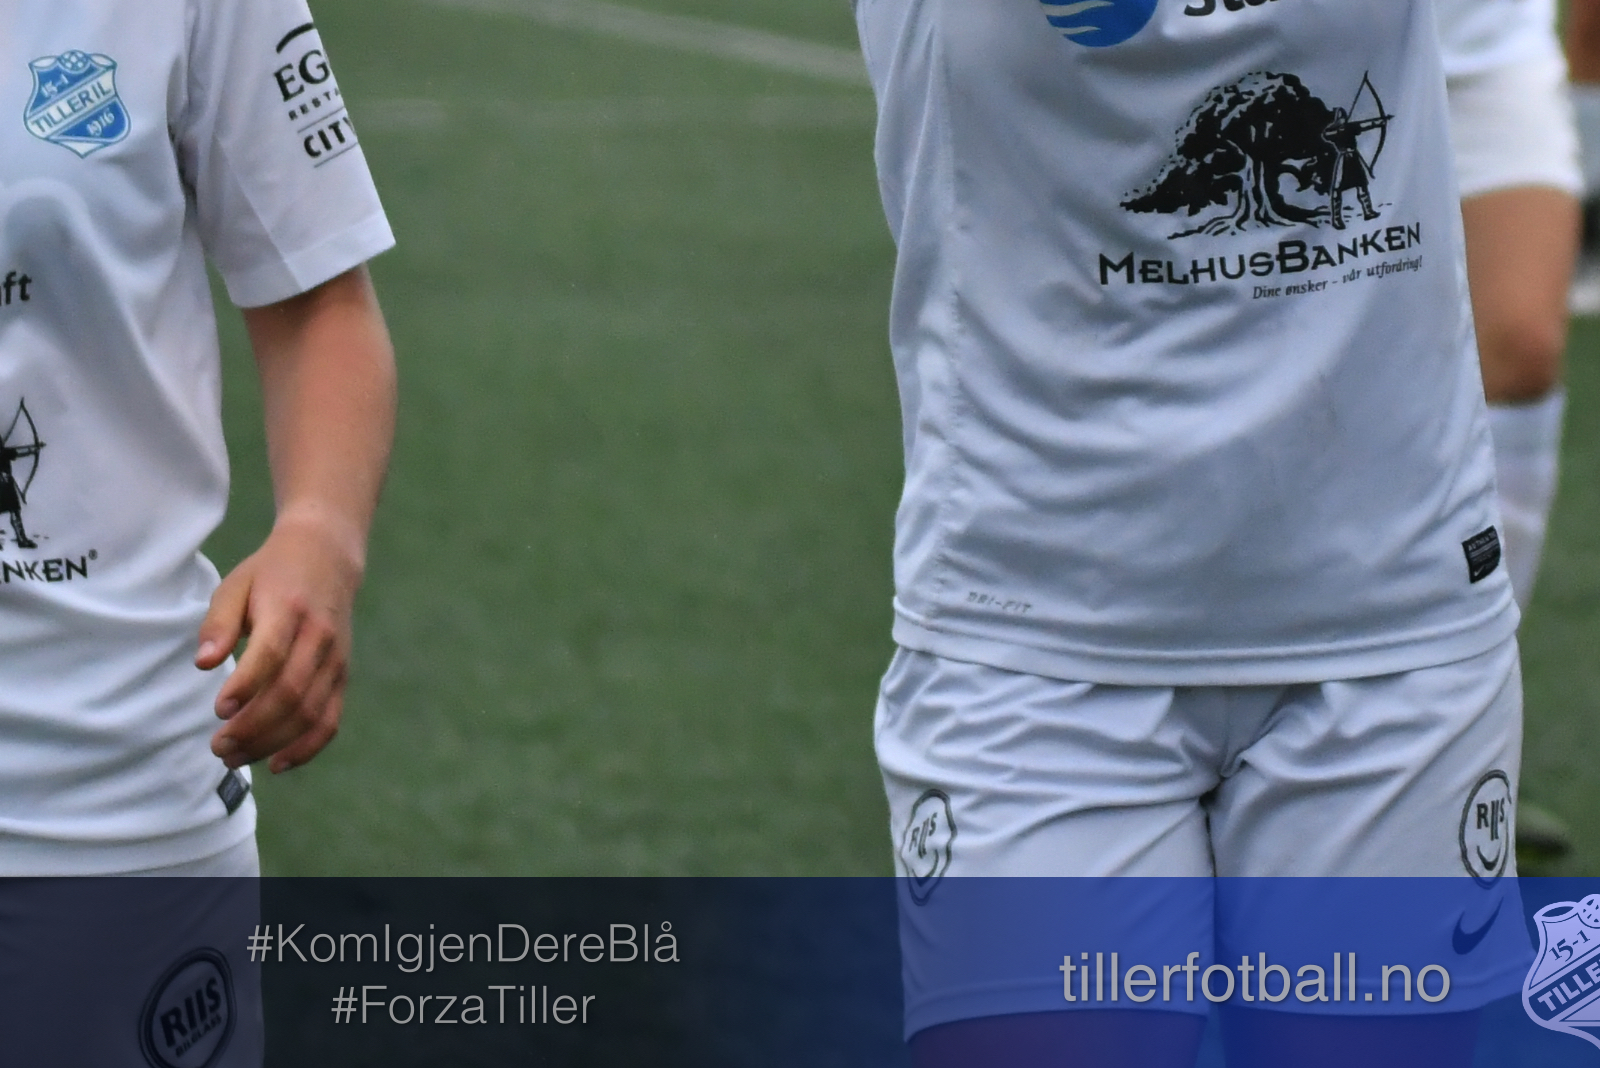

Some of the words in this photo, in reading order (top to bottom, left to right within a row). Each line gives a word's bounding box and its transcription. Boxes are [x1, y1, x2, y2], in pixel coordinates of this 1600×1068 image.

[30, 89, 94, 132] TILLER
[1252, 285, 1282, 299] Dine
[1285, 279, 1329, 296] ønsker
[1477, 797, 1505, 841] RIIS
[160, 978, 221, 1048] RIIS
